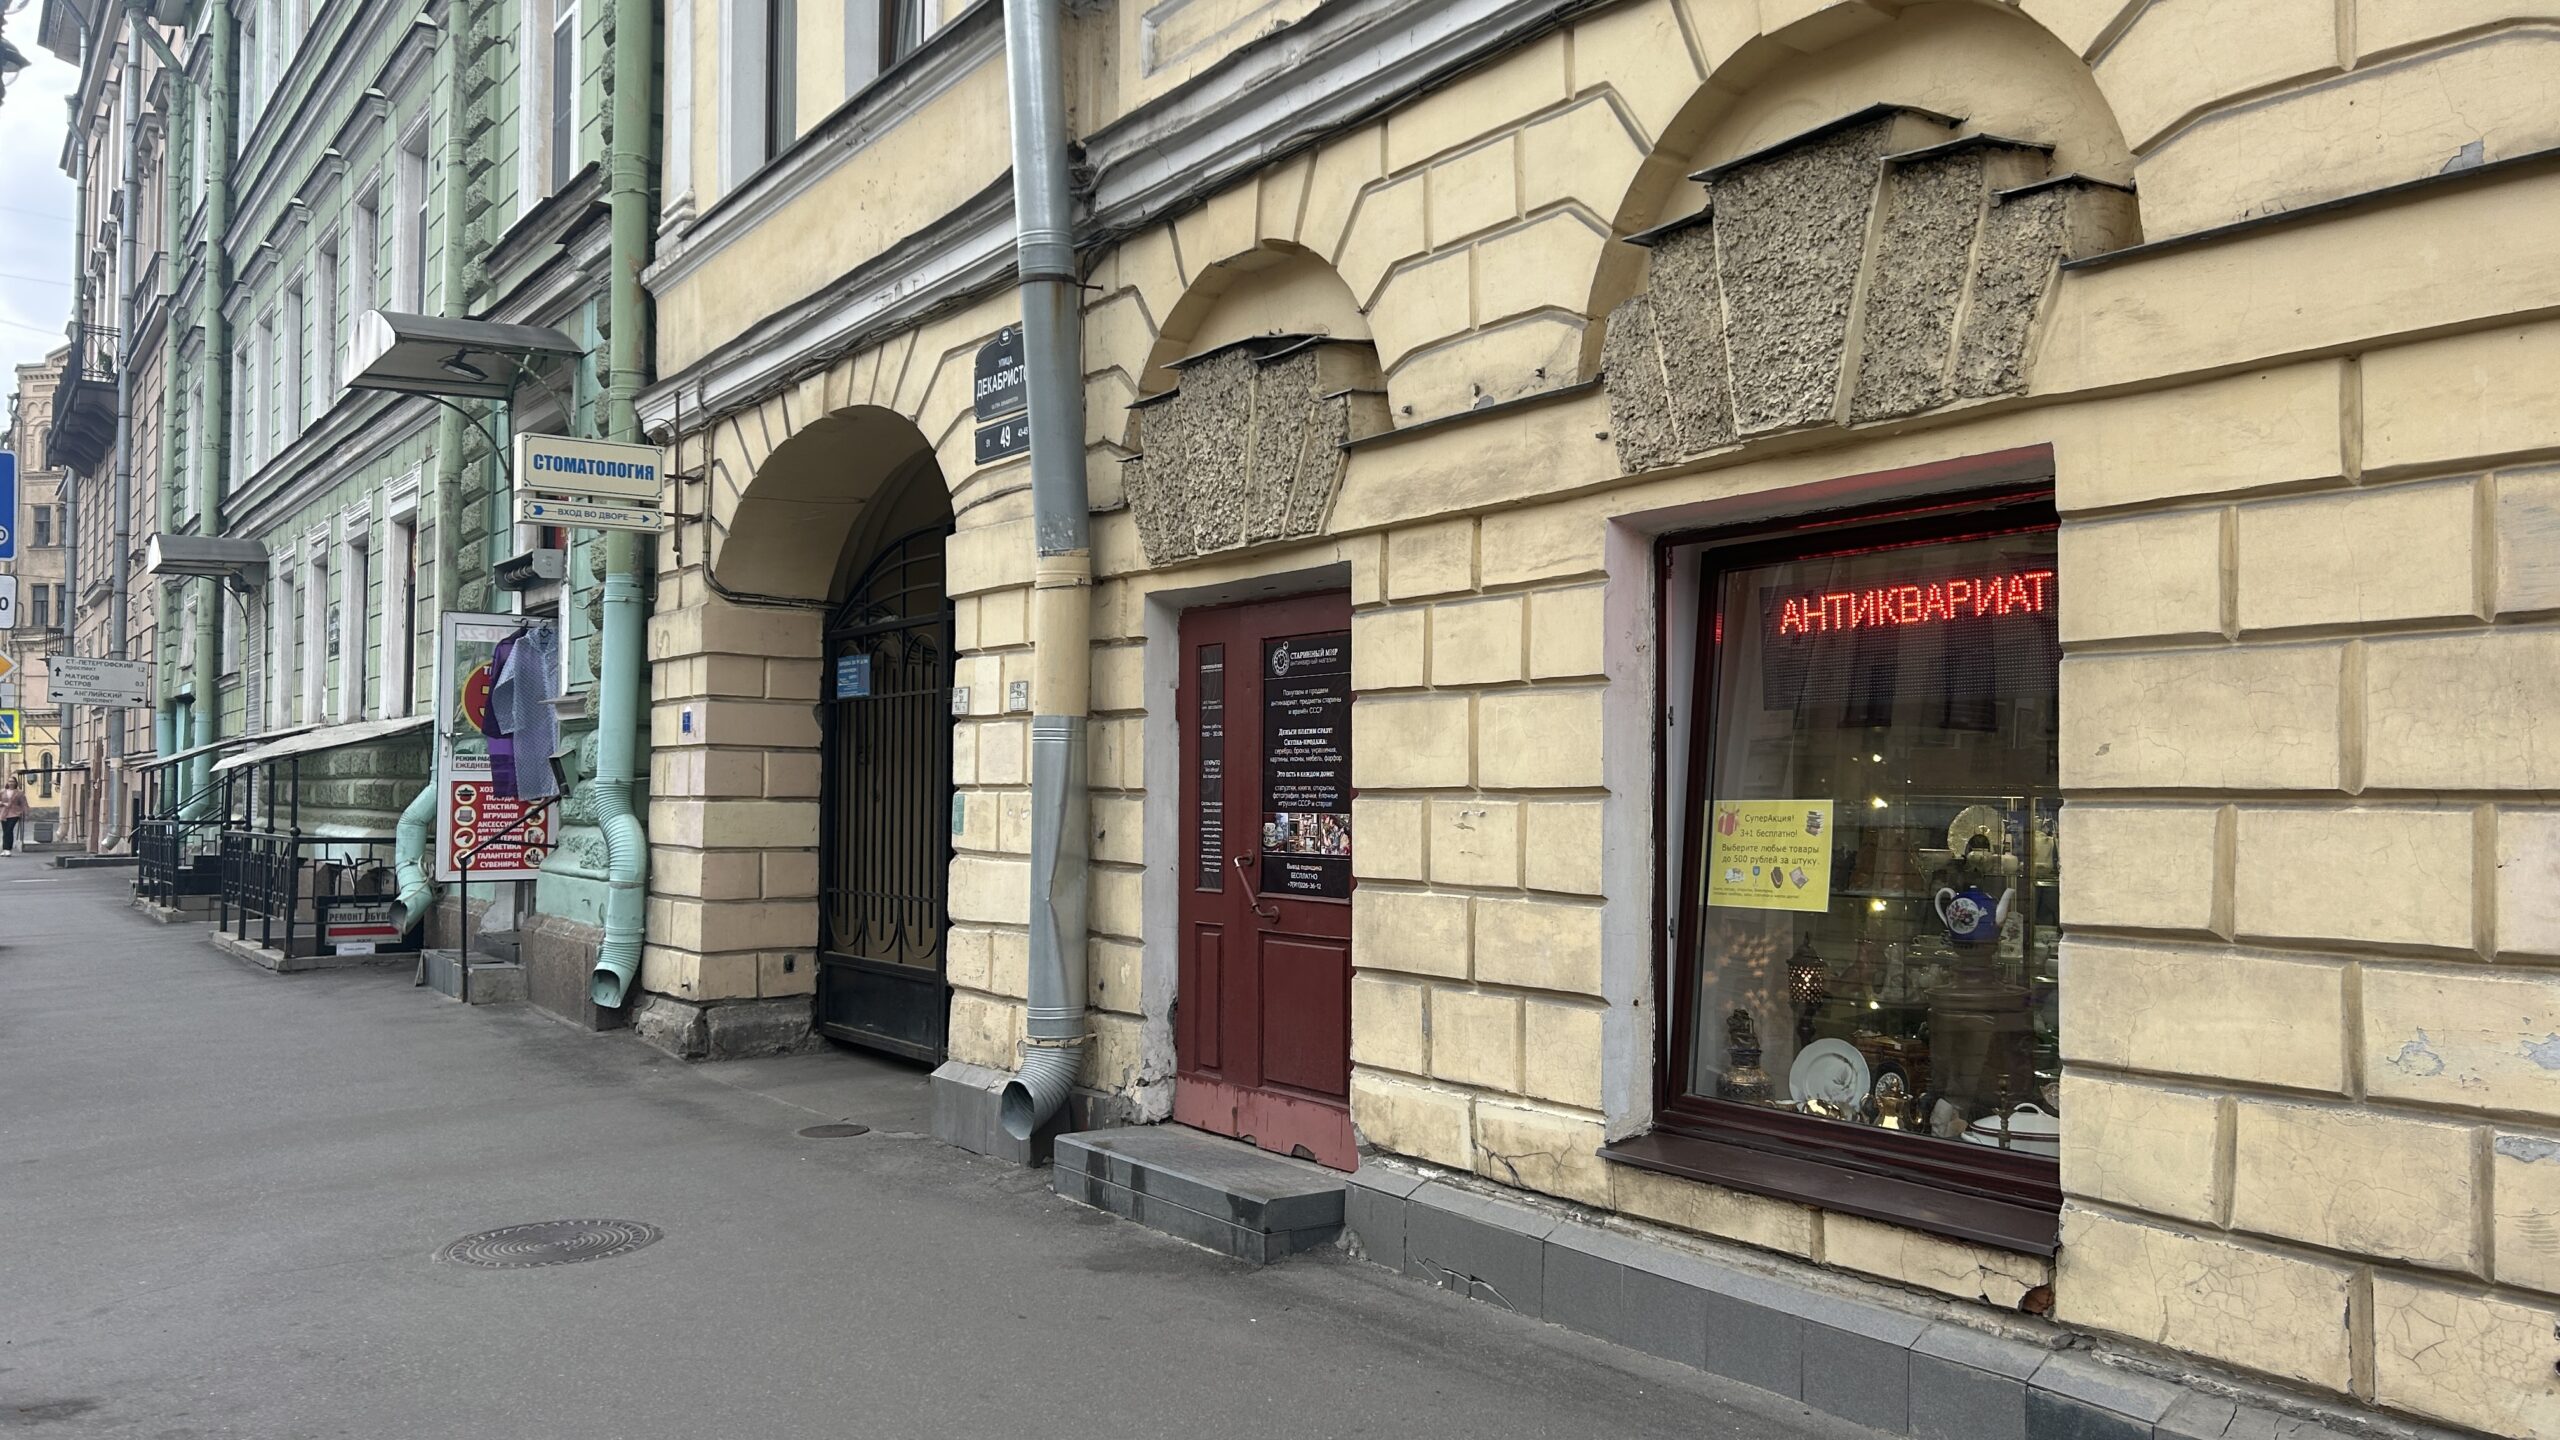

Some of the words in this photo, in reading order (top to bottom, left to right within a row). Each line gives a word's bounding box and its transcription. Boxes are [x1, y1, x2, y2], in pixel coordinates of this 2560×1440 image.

[1000, 426, 1010, 448] 49
[533, 454, 654, 480] СТОМАТОЛОГИЯ
[558, 508, 582, 518] ВХОД
[599, 512, 628, 520] ДВОРЕ
[1780, 571, 2052, 635] АНТИКВАРИАТ
[1744, 814, 1794, 823] СуперАкция!
[1756, 829, 1797, 837] бесплатно!
[1722, 844, 1758, 852] Выберите
[1790, 846, 1819, 854] товары
[1750, 855, 1778, 864] рублей
[1792, 858, 1820, 866] штуку.
[329, 913, 363, 921] РЕМОНТ
